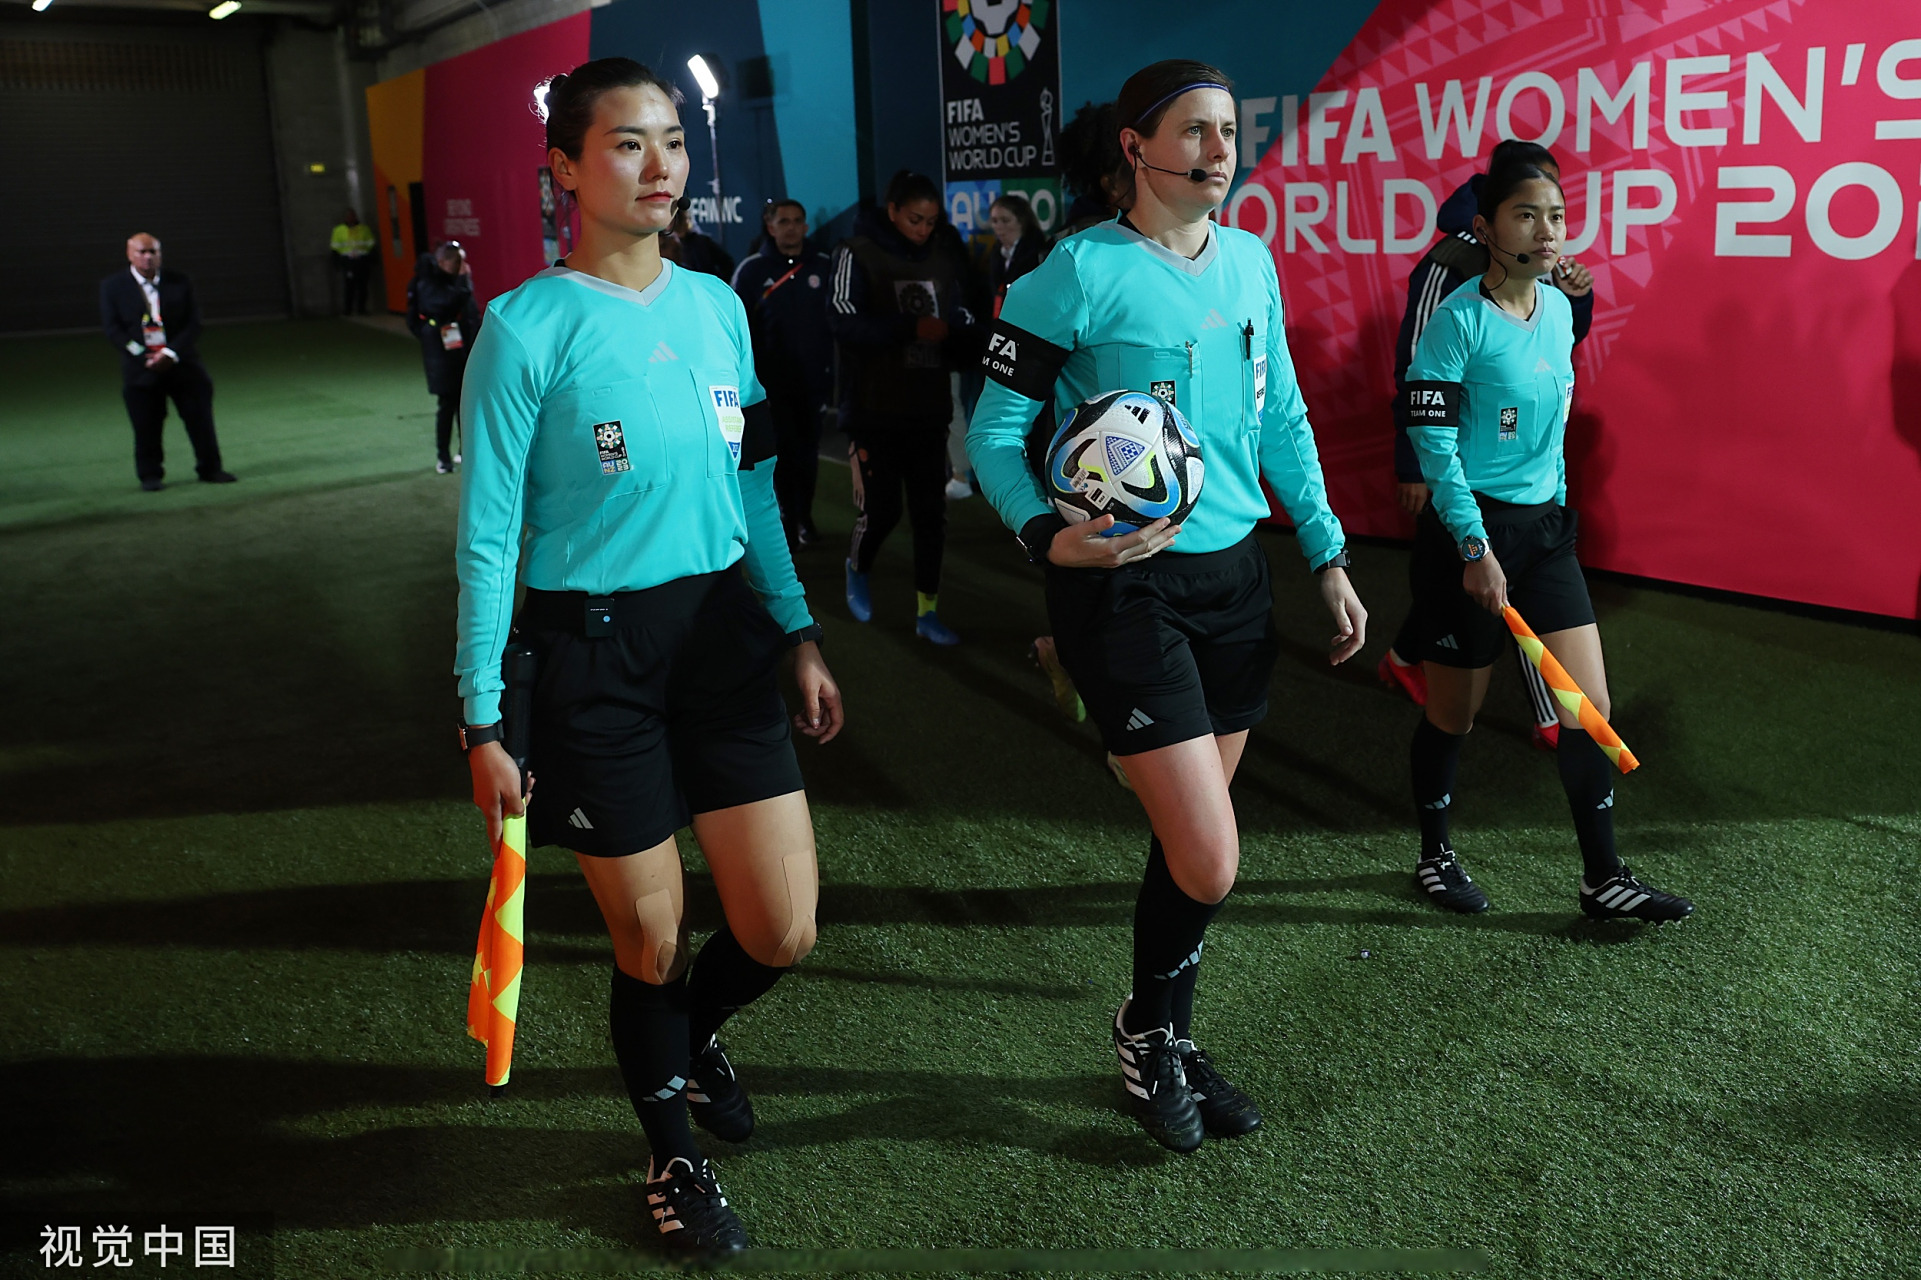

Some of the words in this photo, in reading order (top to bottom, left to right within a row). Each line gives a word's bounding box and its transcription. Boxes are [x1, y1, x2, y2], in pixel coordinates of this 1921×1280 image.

[947, 98, 984, 123] FIFA
[949, 121, 1020, 147] WOMEN'S
[1240, 86, 1397, 168] FIFA
[949, 147, 1002, 170] WORLD
[1004, 145, 1036, 167] CUP
[1216, 178, 1437, 254] ORLD
[1563, 169, 1677, 256] UP
[1715, 161, 1921, 260] 20
[988, 333, 1018, 361] FA
[992, 361, 1015, 377] ONE
[714, 390, 740, 408] FIFA
[1410, 390, 1446, 405] FIFA
